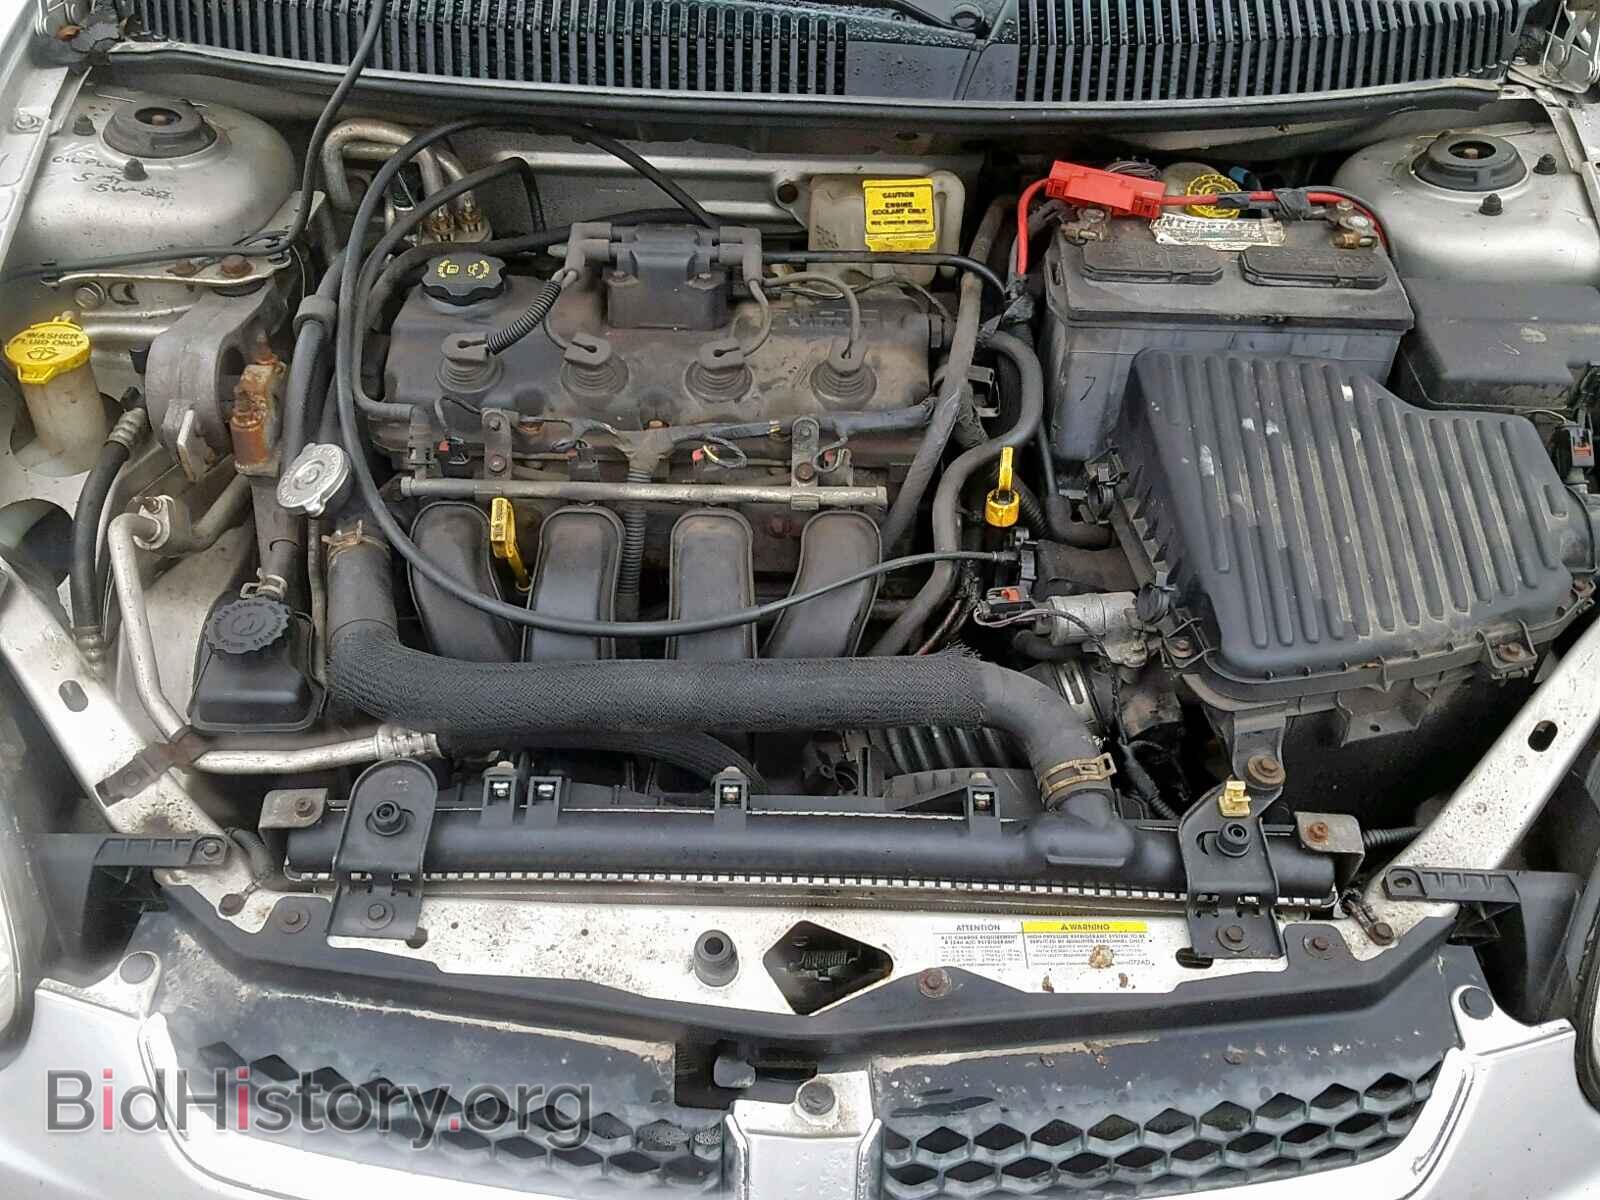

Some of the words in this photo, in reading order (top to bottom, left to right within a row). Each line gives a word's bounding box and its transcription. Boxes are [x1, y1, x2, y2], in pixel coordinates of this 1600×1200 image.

[882, 191, 915, 199] CAUTION
[872, 208, 905, 216] COOLANT
[1069, 923, 1111, 931] WARNING
